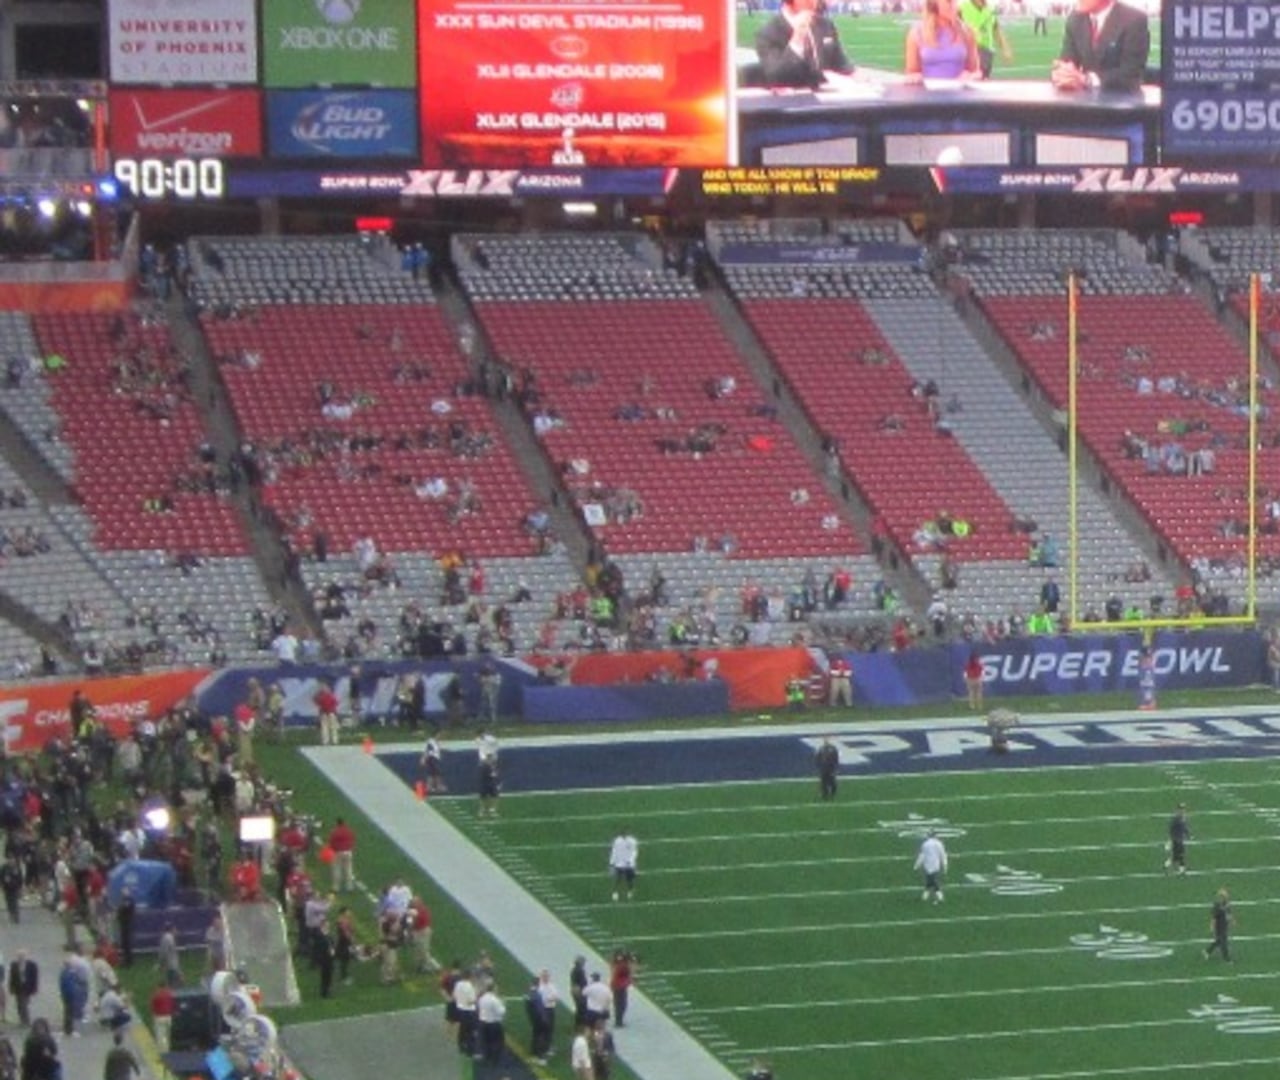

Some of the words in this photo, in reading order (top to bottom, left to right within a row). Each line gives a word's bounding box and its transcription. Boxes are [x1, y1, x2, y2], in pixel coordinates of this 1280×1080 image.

[119, 20, 246, 33] UNIVERSITY
[435, 15, 474, 29] XXX
[477, 15, 516, 29] SUN
[518, 15, 569, 29] DEVIL
[573, 15, 651, 29] STADIUM
[119, 41, 144, 54] OF
[156, 41, 246, 54] PHOENIX
[280, 26, 345, 50] XBOX
[346, 26, 399, 51] ONE
[512, 64, 607, 79] GLENDALE
[322, 105, 384, 123] BUD
[476, 112, 518, 128] XLIX
[520, 112, 614, 128] GLENDALE
[137, 128, 232, 152] verizon
[310, 124, 391, 140] LIGHT
[114, 158, 223, 197] 90:00
[320, 176, 368, 188] SUPER
[368, 176, 405, 188] BOWL
[400, 169, 520, 195] XLIX
[517, 175, 583, 188] ARIZONA
[999, 173, 1042, 185] SUPER
[1043, 173, 1078, 185] BOWL
[1072, 167, 1183, 192] XLIX
[1179, 172, 1240, 185] ARIZONA
[978, 650, 1111, 681] SUPER
[1069, 932, 1174, 960] 30
